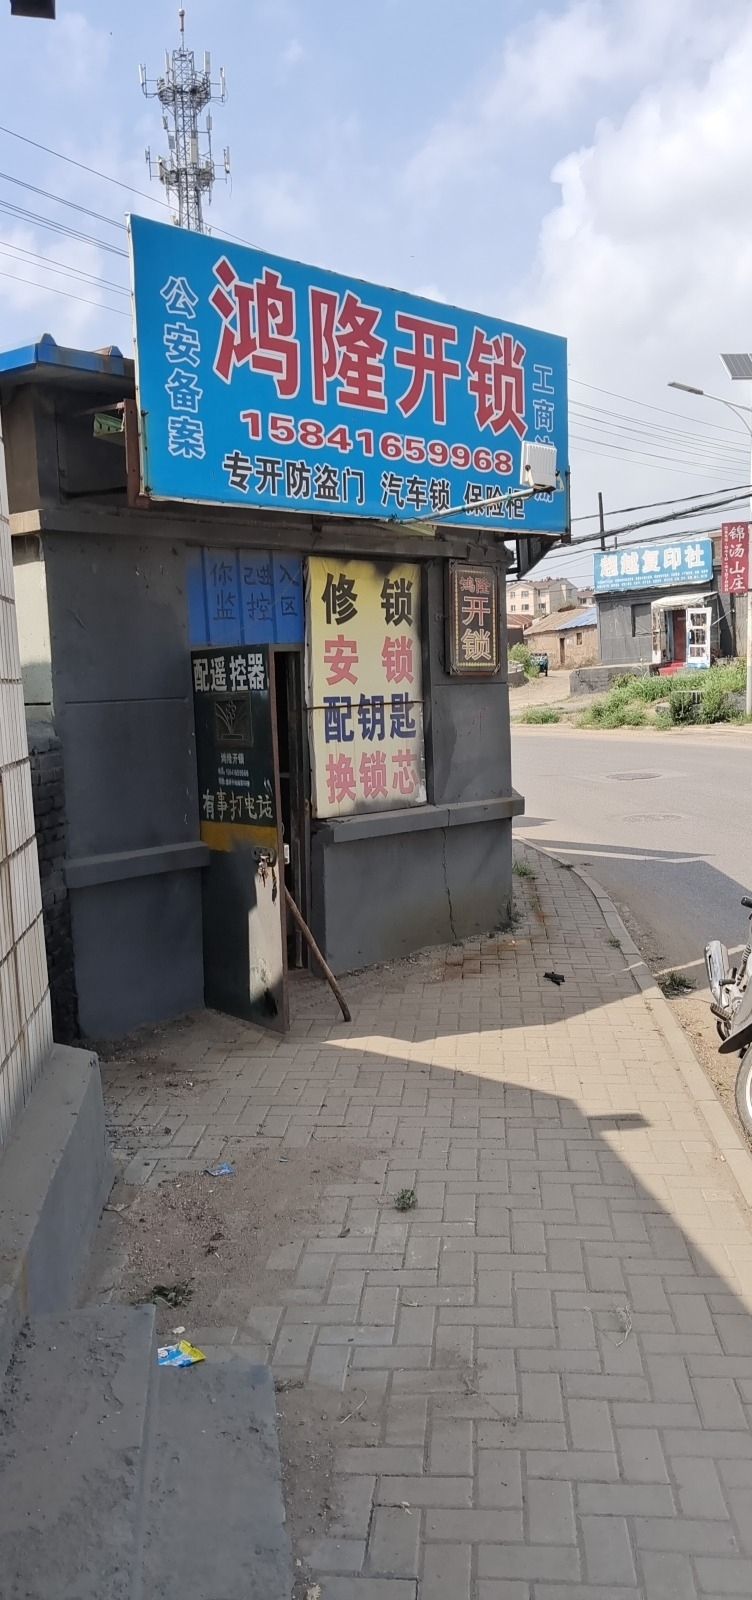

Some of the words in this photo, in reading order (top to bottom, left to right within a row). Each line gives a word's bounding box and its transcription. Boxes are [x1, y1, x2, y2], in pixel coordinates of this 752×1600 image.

[160, 276, 206, 459] 公安备案
[208, 256, 528, 440] 鸿隆开锁
[239, 409, 514, 475] 15841659968
[532, 363, 555, 503] 工商
[222, 451, 366, 506] 专开防盗门
[380, 472, 452, 513] 汽车锁
[463, 481, 526, 521] 保险柜
[460, 576, 491, 594] 鸿隆
[729, 525, 746, 591] 锦汤山庄
[213, 588, 298, 621] 监控区
[461, 596, 491, 661] 开锁
[193, 653, 265, 693] 配遥控器
[322, 693, 417, 744] 配钥匙
[202, 787, 273, 821] 有事打电话
[326, 748, 418, 804] 换锁芯
